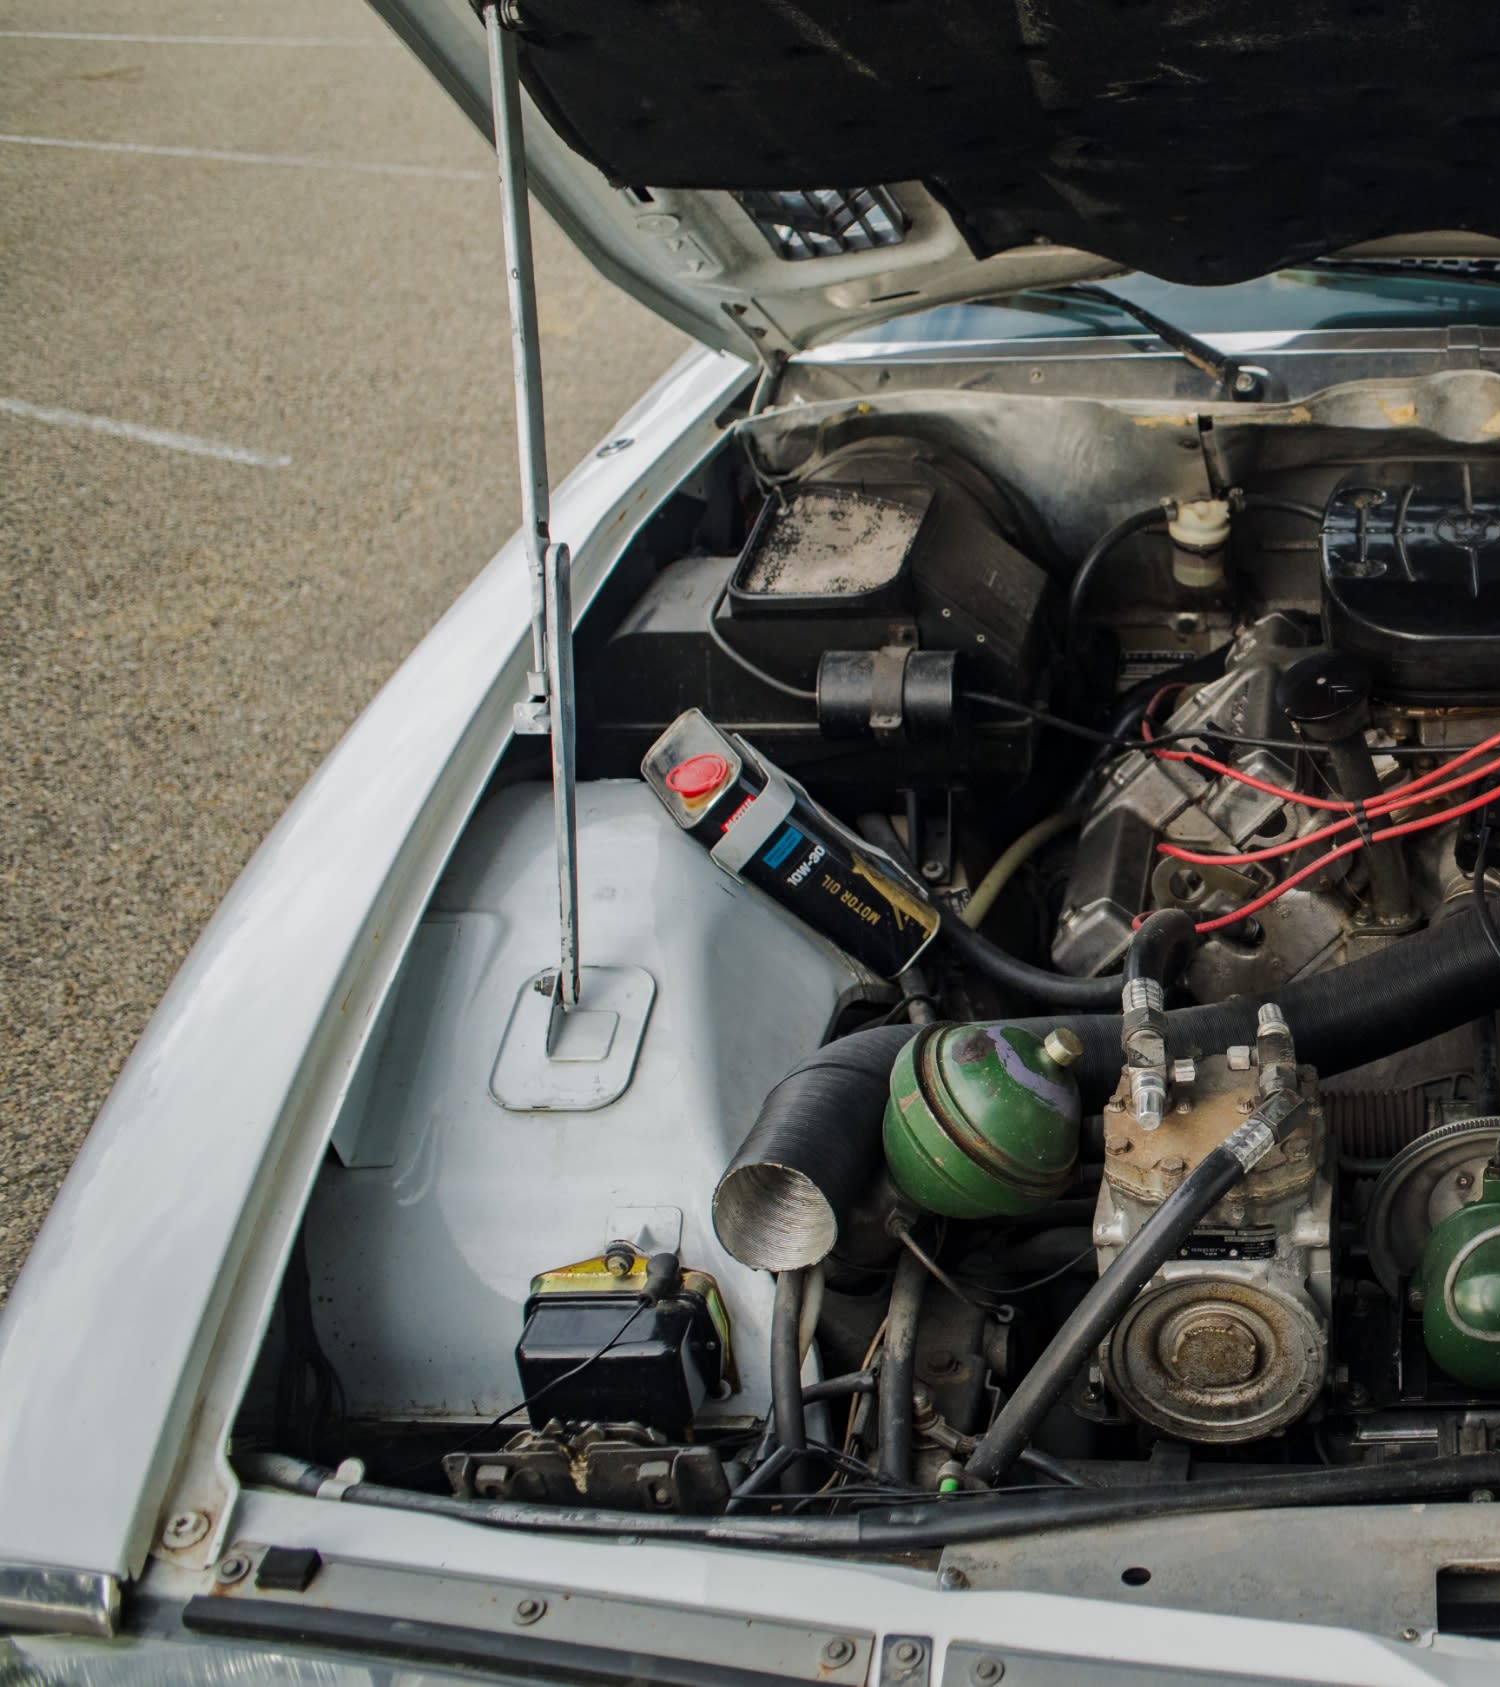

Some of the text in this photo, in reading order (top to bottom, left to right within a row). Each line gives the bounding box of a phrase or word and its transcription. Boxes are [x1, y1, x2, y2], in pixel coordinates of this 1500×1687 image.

[786, 845, 826, 887] 10W-30
[822, 873, 881, 925] MOTOR OIL
